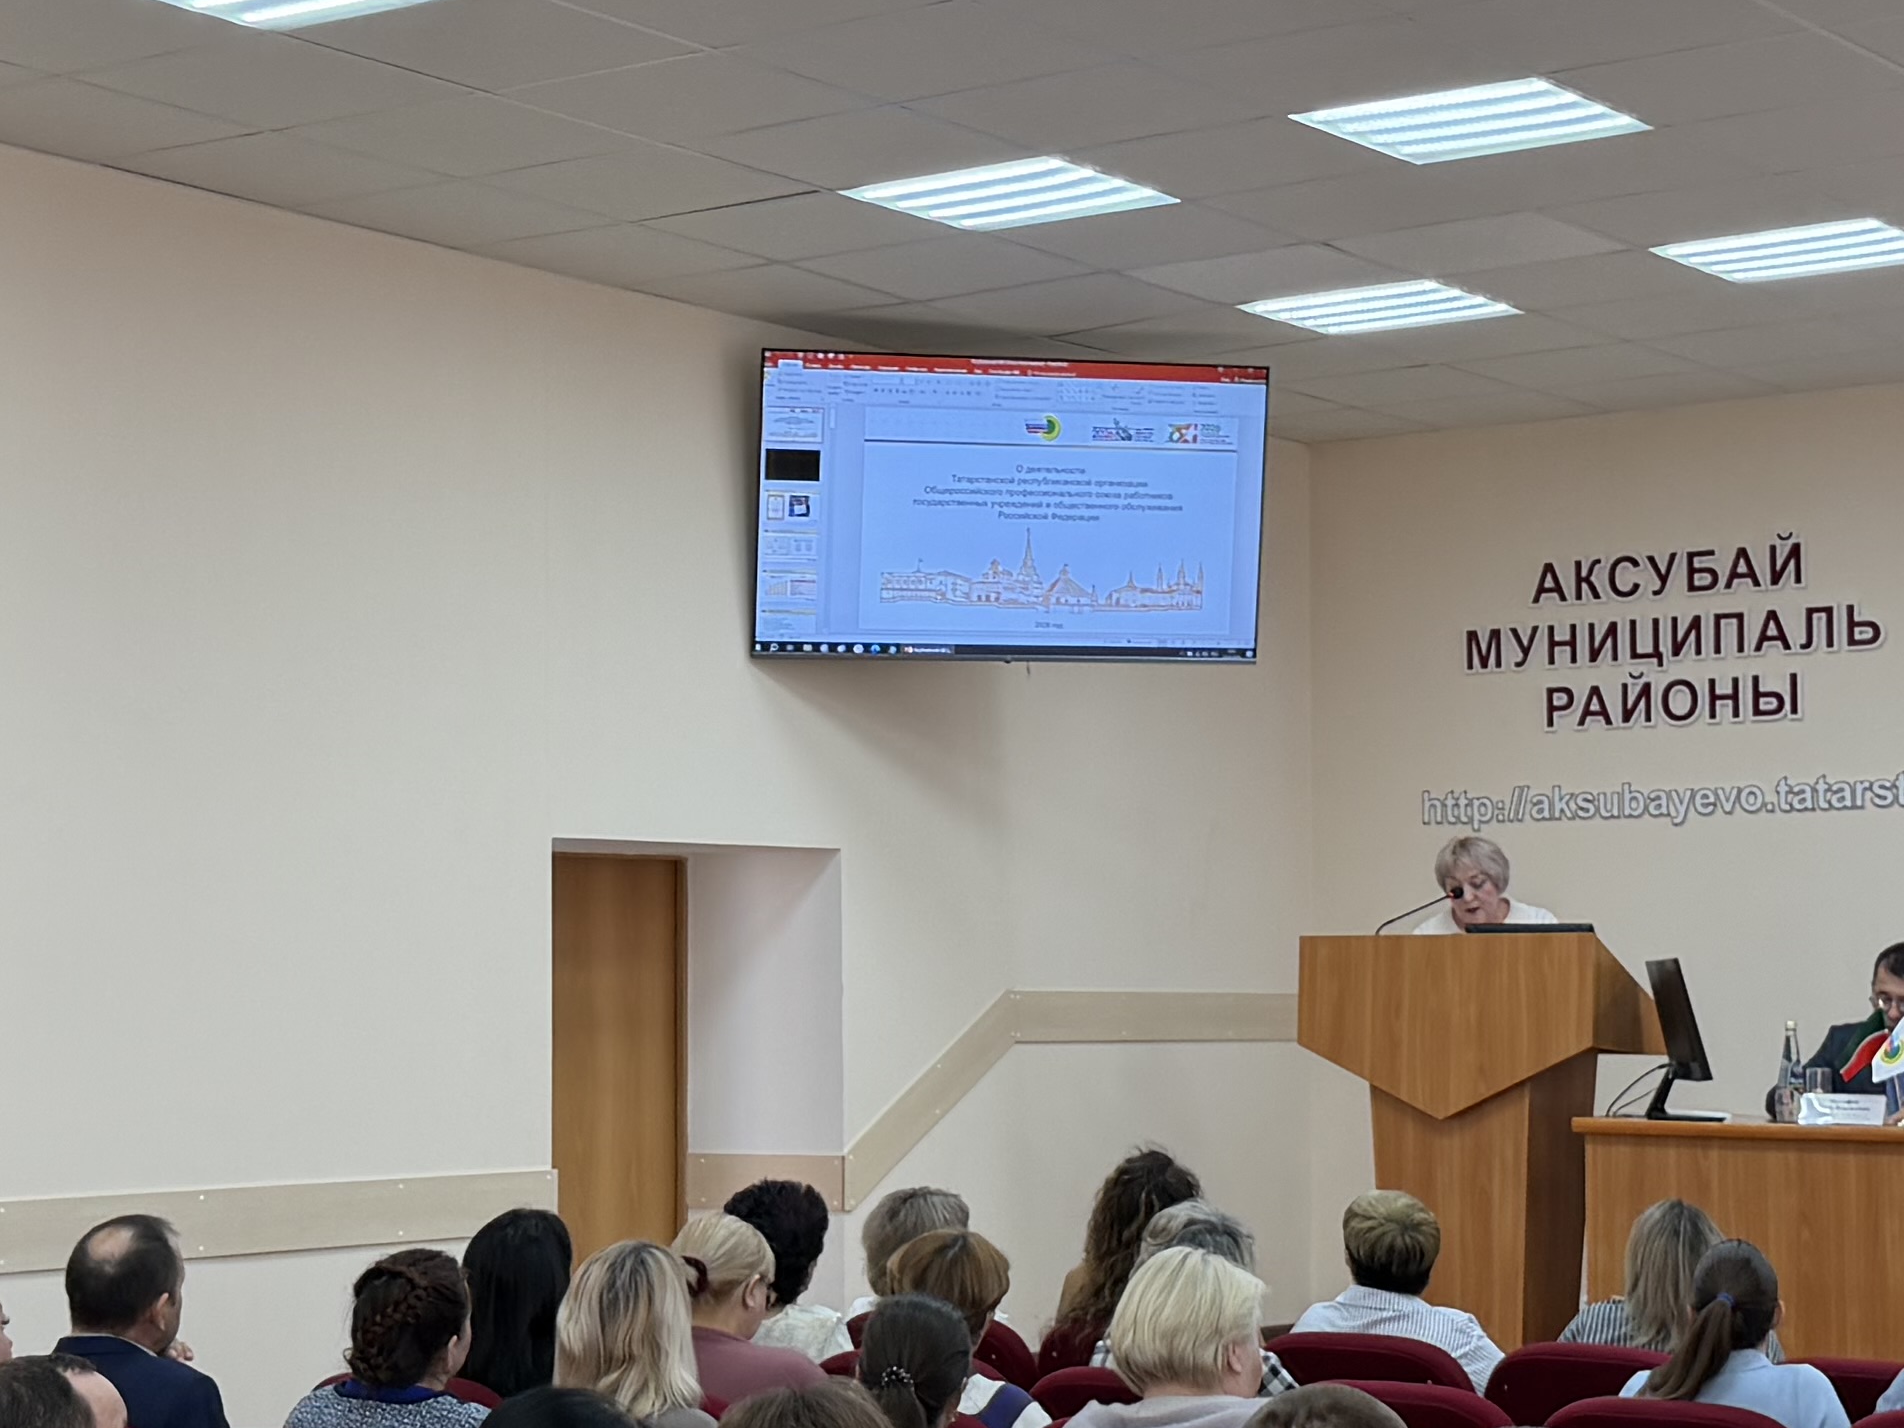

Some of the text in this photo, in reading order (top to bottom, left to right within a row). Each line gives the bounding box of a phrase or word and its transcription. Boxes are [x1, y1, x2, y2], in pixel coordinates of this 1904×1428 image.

[1530, 533, 1804, 605] АКСУБАЙ
[1464, 604, 1883, 672] МУНИЦИПАЛЬ
[1543, 672, 1801, 730] РАЙОНЫ
